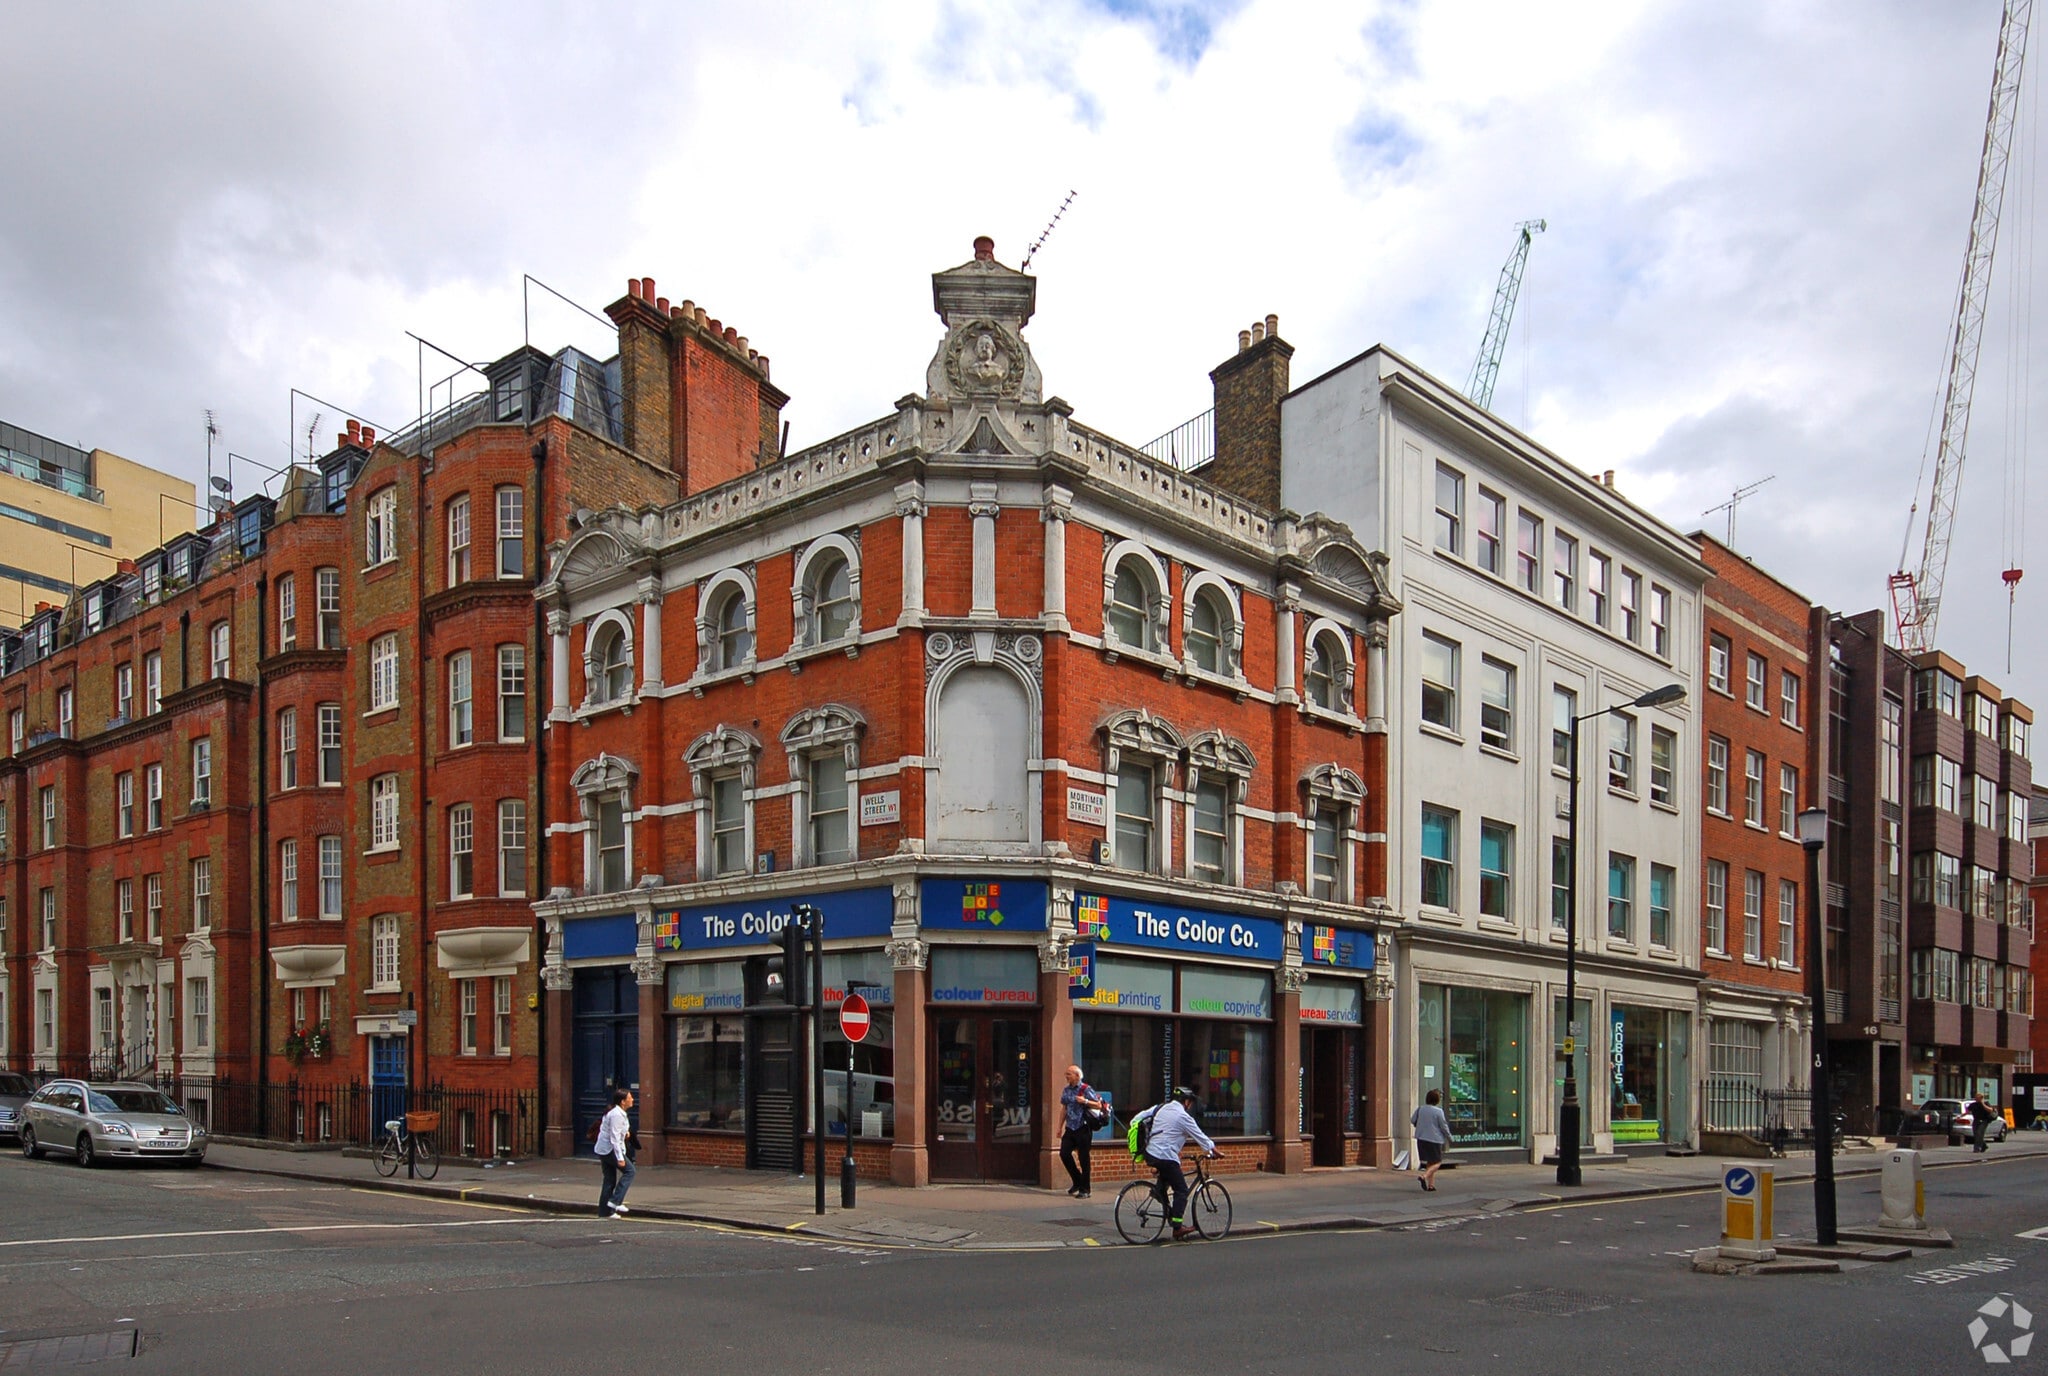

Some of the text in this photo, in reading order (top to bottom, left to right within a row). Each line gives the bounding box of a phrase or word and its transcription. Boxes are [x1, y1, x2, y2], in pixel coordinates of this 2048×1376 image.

[865, 795, 885, 806] WELLS
[1070, 791, 1103, 806] MORTIMER
[865, 804, 886, 816] STREET
[1070, 801, 1092, 813] STREET
[702, 915, 735, 938] The
[741, 910, 791, 936] Color
[1134, 910, 1259, 948] The Color Co.
[1863, 1026, 1878, 1035] 16
[1615, 1022, 1624, 1084] ROBOTS
